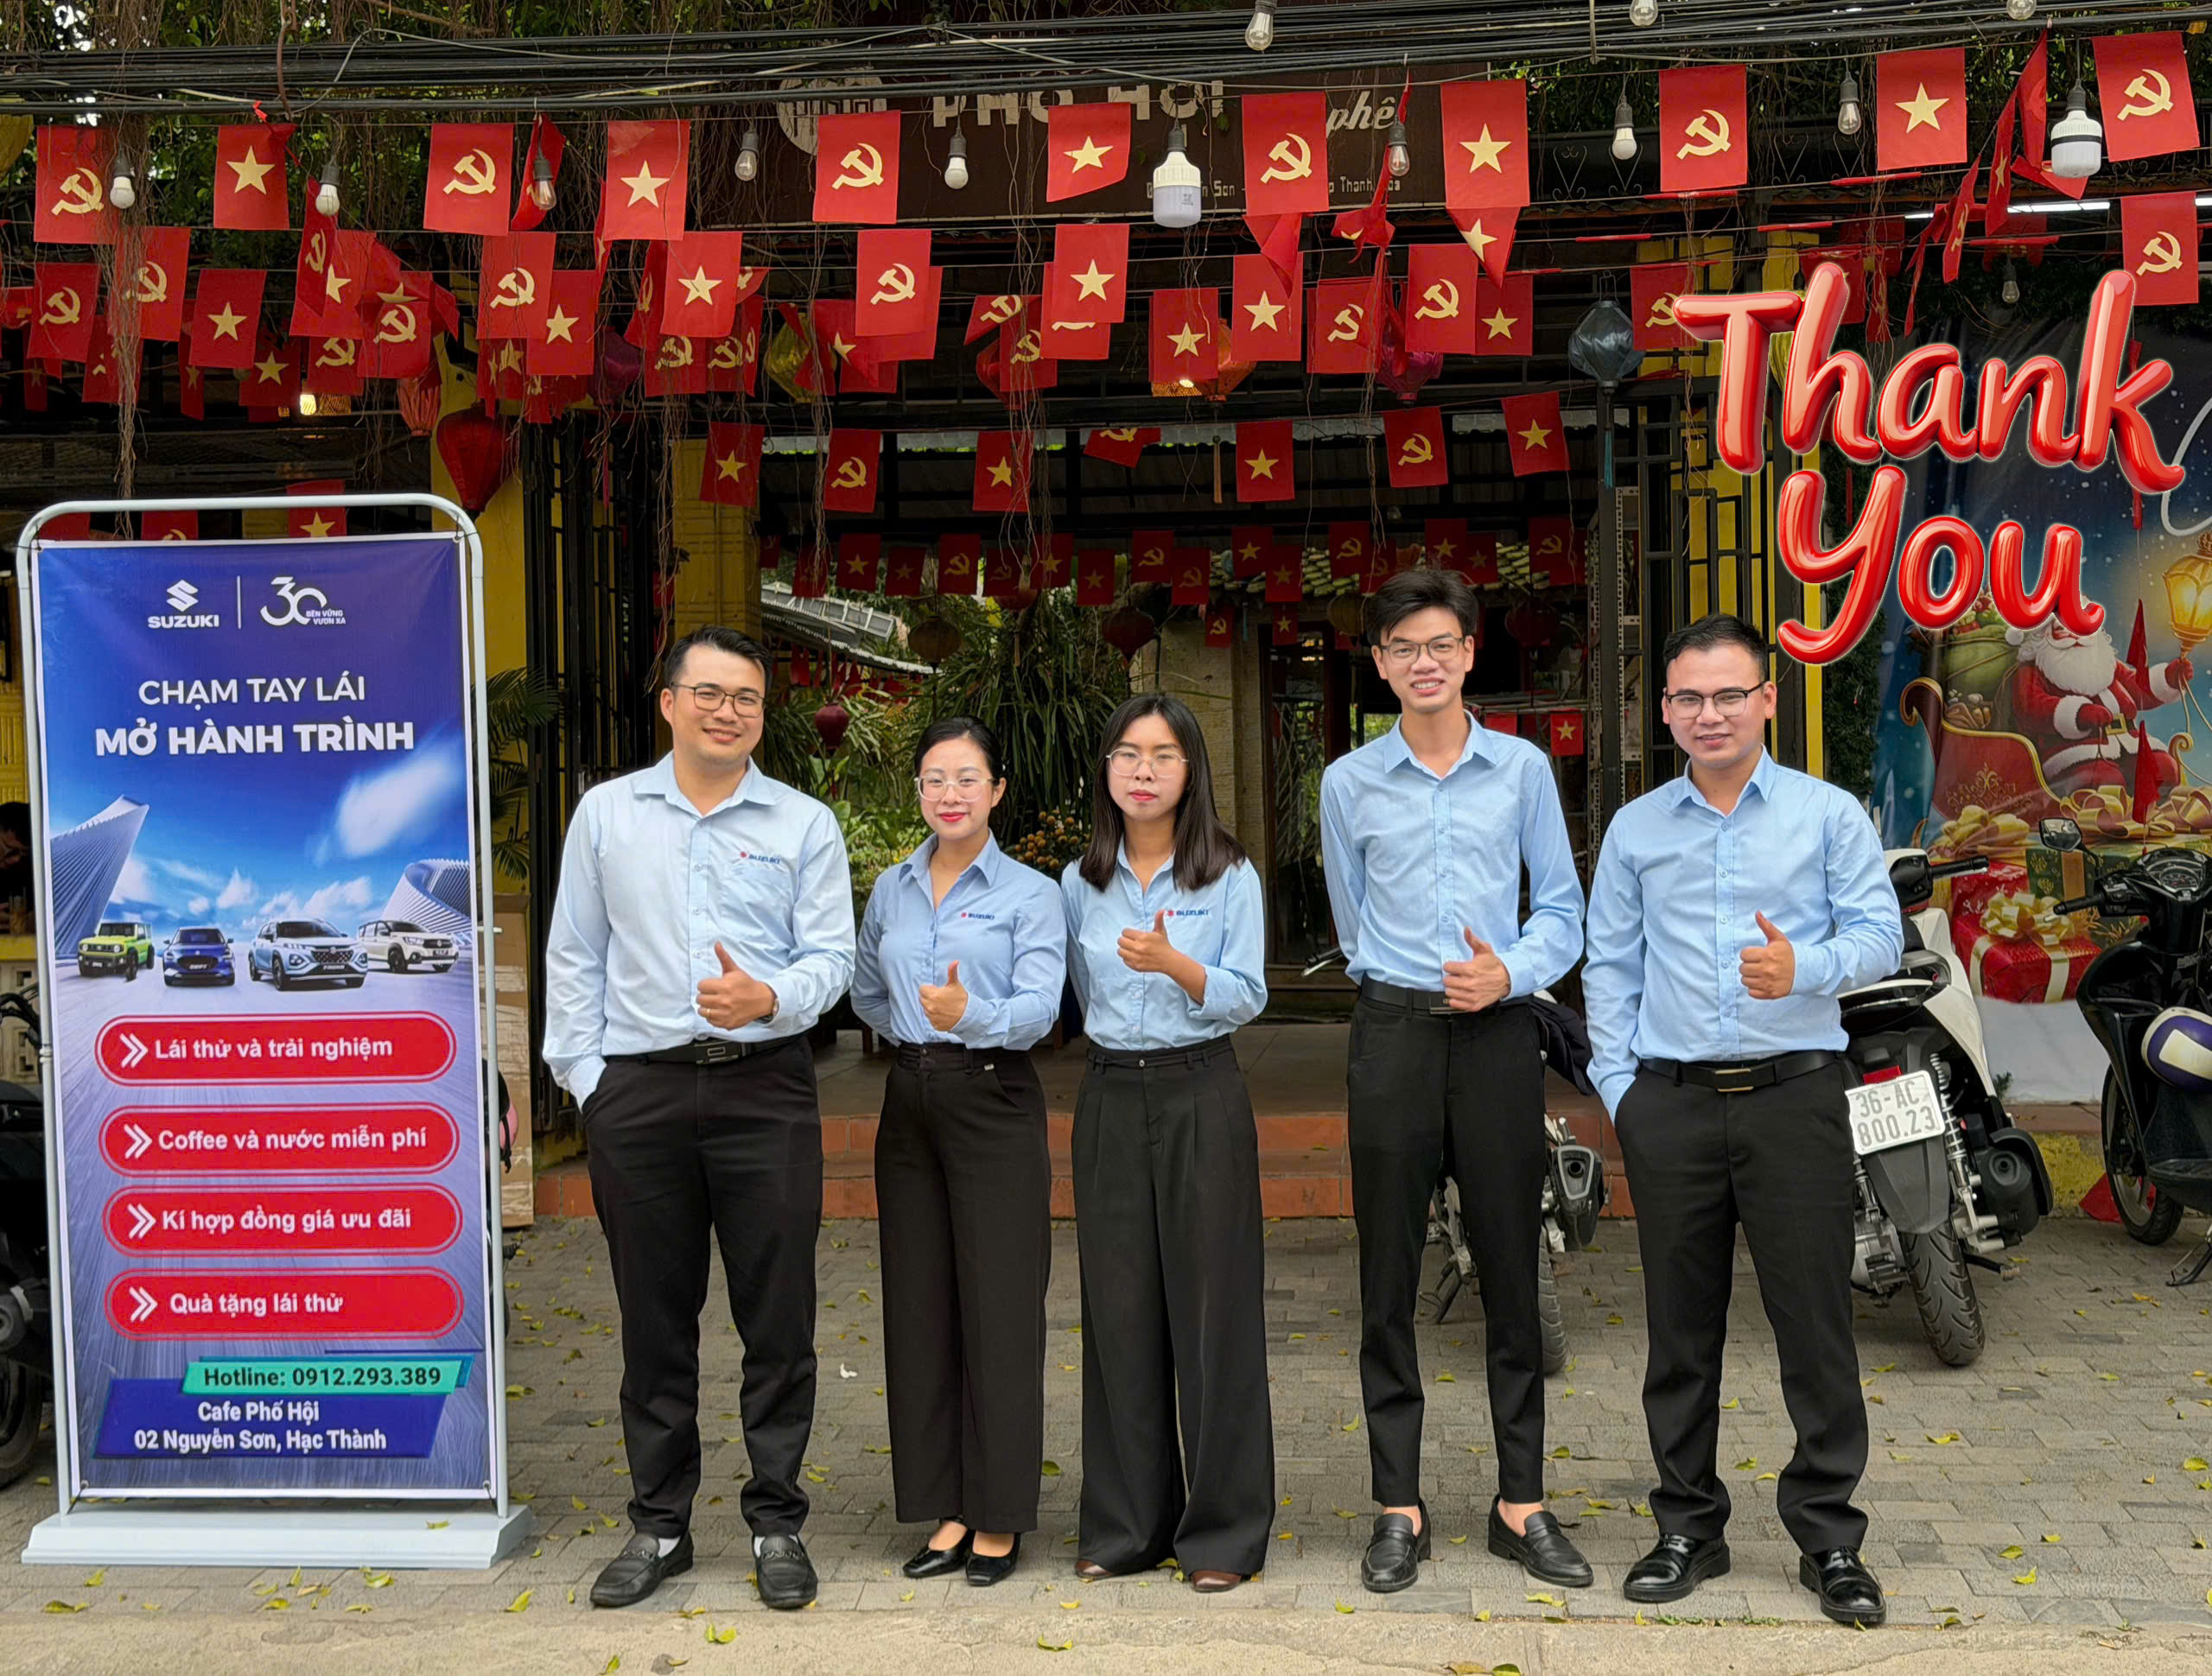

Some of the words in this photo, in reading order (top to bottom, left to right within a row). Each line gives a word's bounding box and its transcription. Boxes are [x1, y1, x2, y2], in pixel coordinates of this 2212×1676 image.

[148, 614, 219, 629] SUZUKI
[139, 680, 238, 710] CHẠM
[246, 678, 306, 702] TAY
[317, 670, 365, 701] LÁI
[96, 718, 157, 756] MỞ
[168, 719, 283, 754] HÀNH
[293, 715, 414, 752] TRÌNH
[155, 1039, 187, 1058] Lái
[194, 1039, 232, 1058] thử
[237, 1038, 262, 1057] và
[269, 1038, 303, 1057] trải
[311, 1038, 393, 1061] nghiệm
[1855, 1080, 1920, 1118] 36-AC
[159, 1130, 227, 1150] Coffee
[234, 1129, 259, 1149] và
[266, 1129, 325, 1148] nước
[332, 1125, 385, 1147] miễn
[392, 1127, 427, 1151] phí
[1856, 1105, 1936, 1147] 800.23
[192, 1210, 234, 1234] hợp
[240, 1205, 295, 1233] đồng
[302, 1209, 334, 1233] giá
[342, 1213, 371, 1228] ưu
[378, 1209, 410, 1228] đãi
[219, 1294, 266, 1318] tặng
[273, 1292, 297, 1312] lái
[304, 1293, 343, 1312] thử
[204, 1368, 285, 1387] Hotline:
[292, 1367, 442, 1387] 0912.293.389
[198, 1401, 241, 1421] Cafe
[246, 1400, 283, 1421] Phố
[288, 1401, 319, 1425] Hội
[134, 1430, 158, 1449] 02
[163, 1428, 234, 1453] Nguyễn
[239, 1430, 281, 1452] Sơn,
[287, 1430, 323, 1453] Hạc
[327, 1429, 386, 1450] Thành
